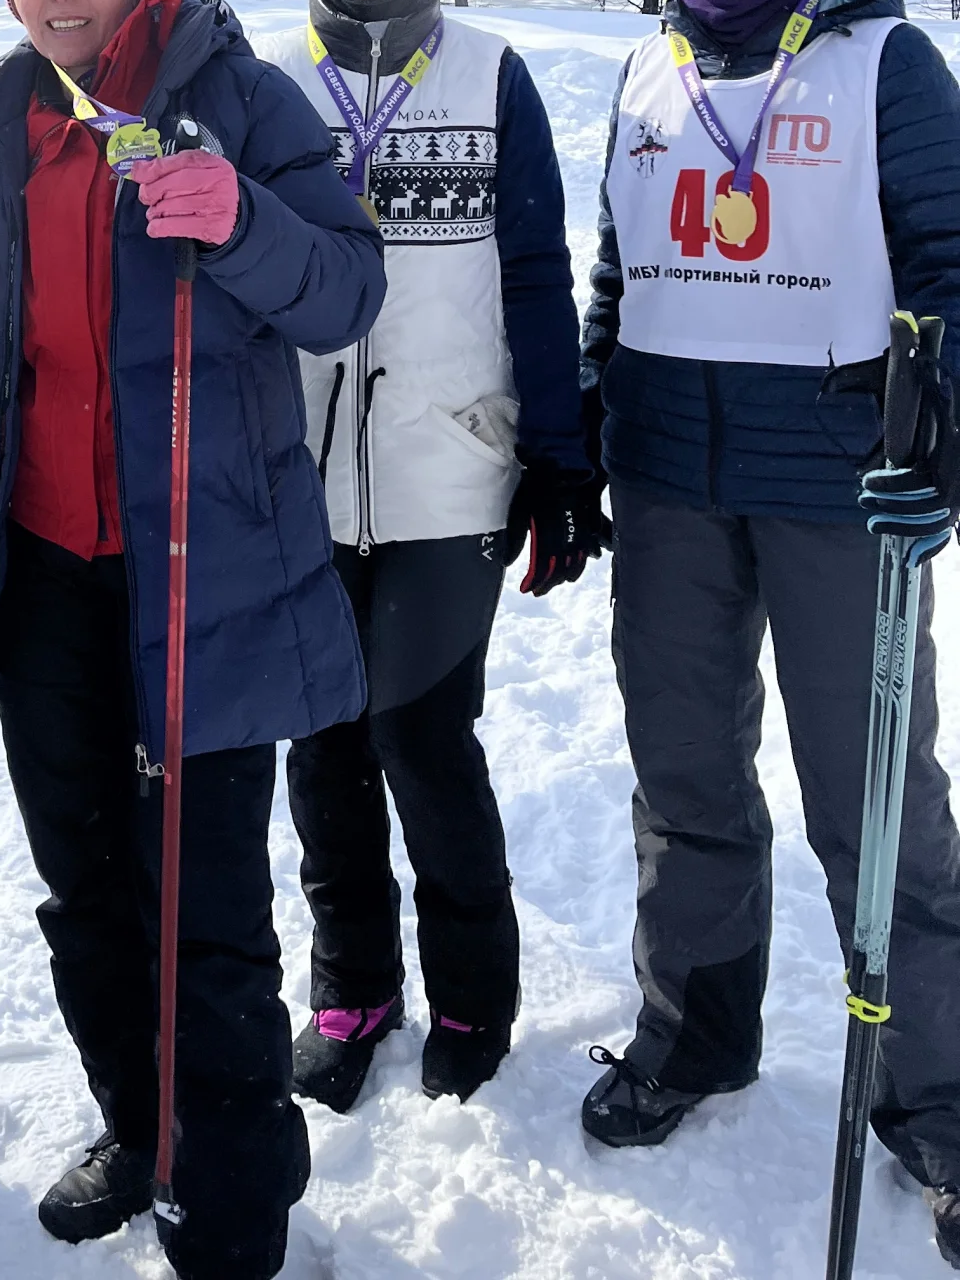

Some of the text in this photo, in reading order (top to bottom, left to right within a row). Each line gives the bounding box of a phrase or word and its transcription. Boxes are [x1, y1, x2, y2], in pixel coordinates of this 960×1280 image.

[786, 19, 805, 48] RACE
[324, 66, 354, 112] СЕВЕРНАЯ
[361, 81, 408, 146] ОДСНЕЖНИКИ
[407, 55, 426, 81] RACE
[397, 108, 450, 122] MOAX
[768, 114, 831, 153] ГТО
[628, 264, 661, 281] МБУ
[766, 273, 832, 291] город»
[565, 510, 575, 542] MOAX
